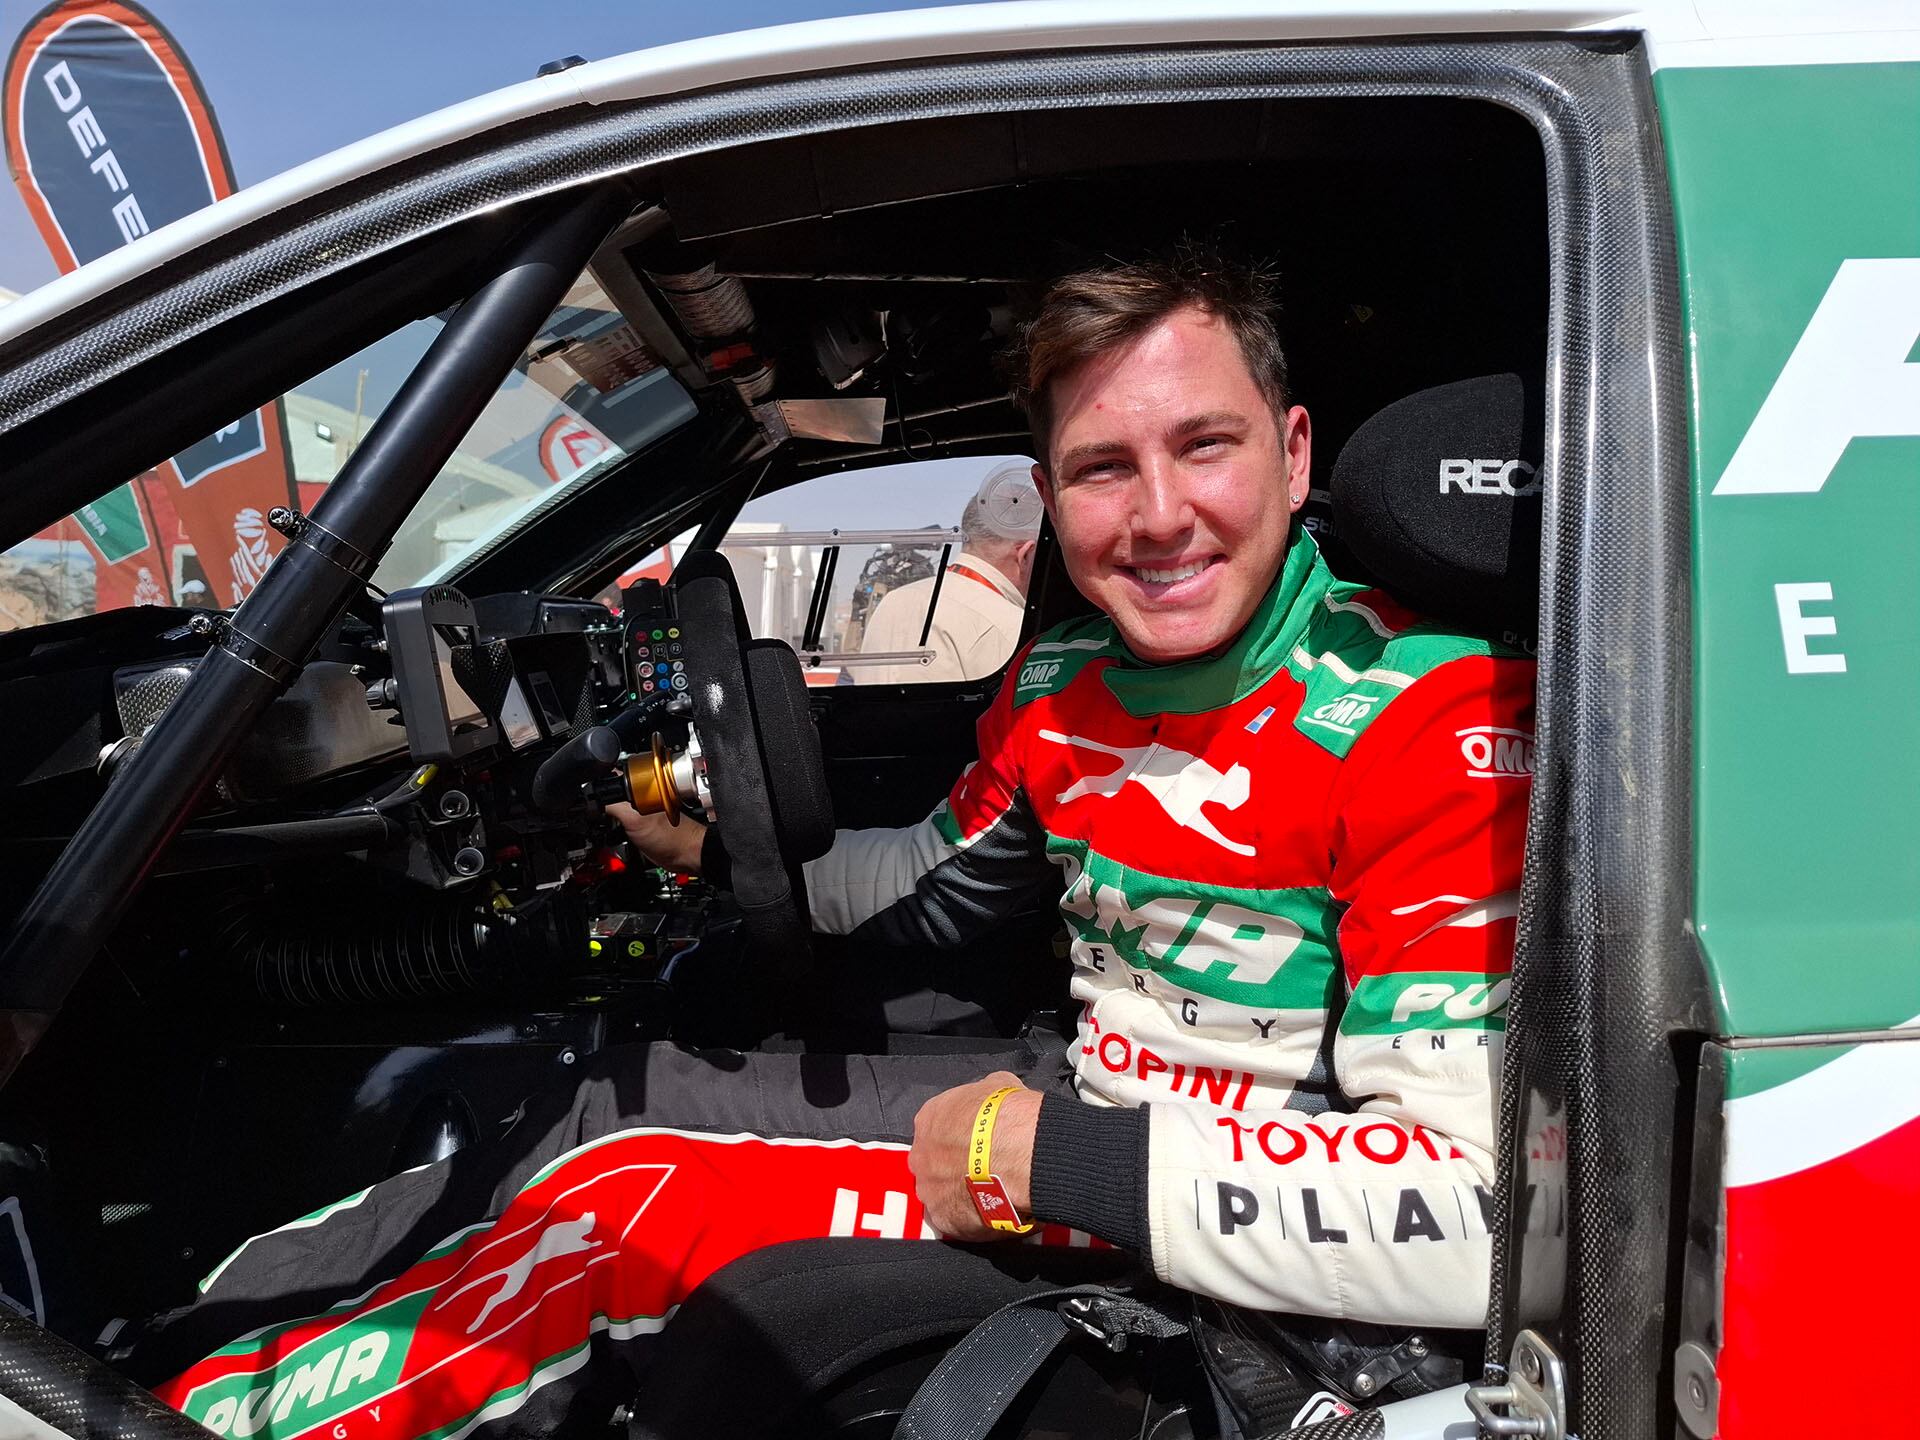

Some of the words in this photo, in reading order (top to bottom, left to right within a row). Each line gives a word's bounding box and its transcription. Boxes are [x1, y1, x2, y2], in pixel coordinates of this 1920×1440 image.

[43, 60, 150, 244] DEFE
[1020, 663, 1061, 685] OMP
[1313, 698, 1371, 726] OMP
[1391, 978, 1512, 1023] PU
[1216, 1116, 1465, 1166] TOYOT
[202, 1330, 390, 1438] PUMA
